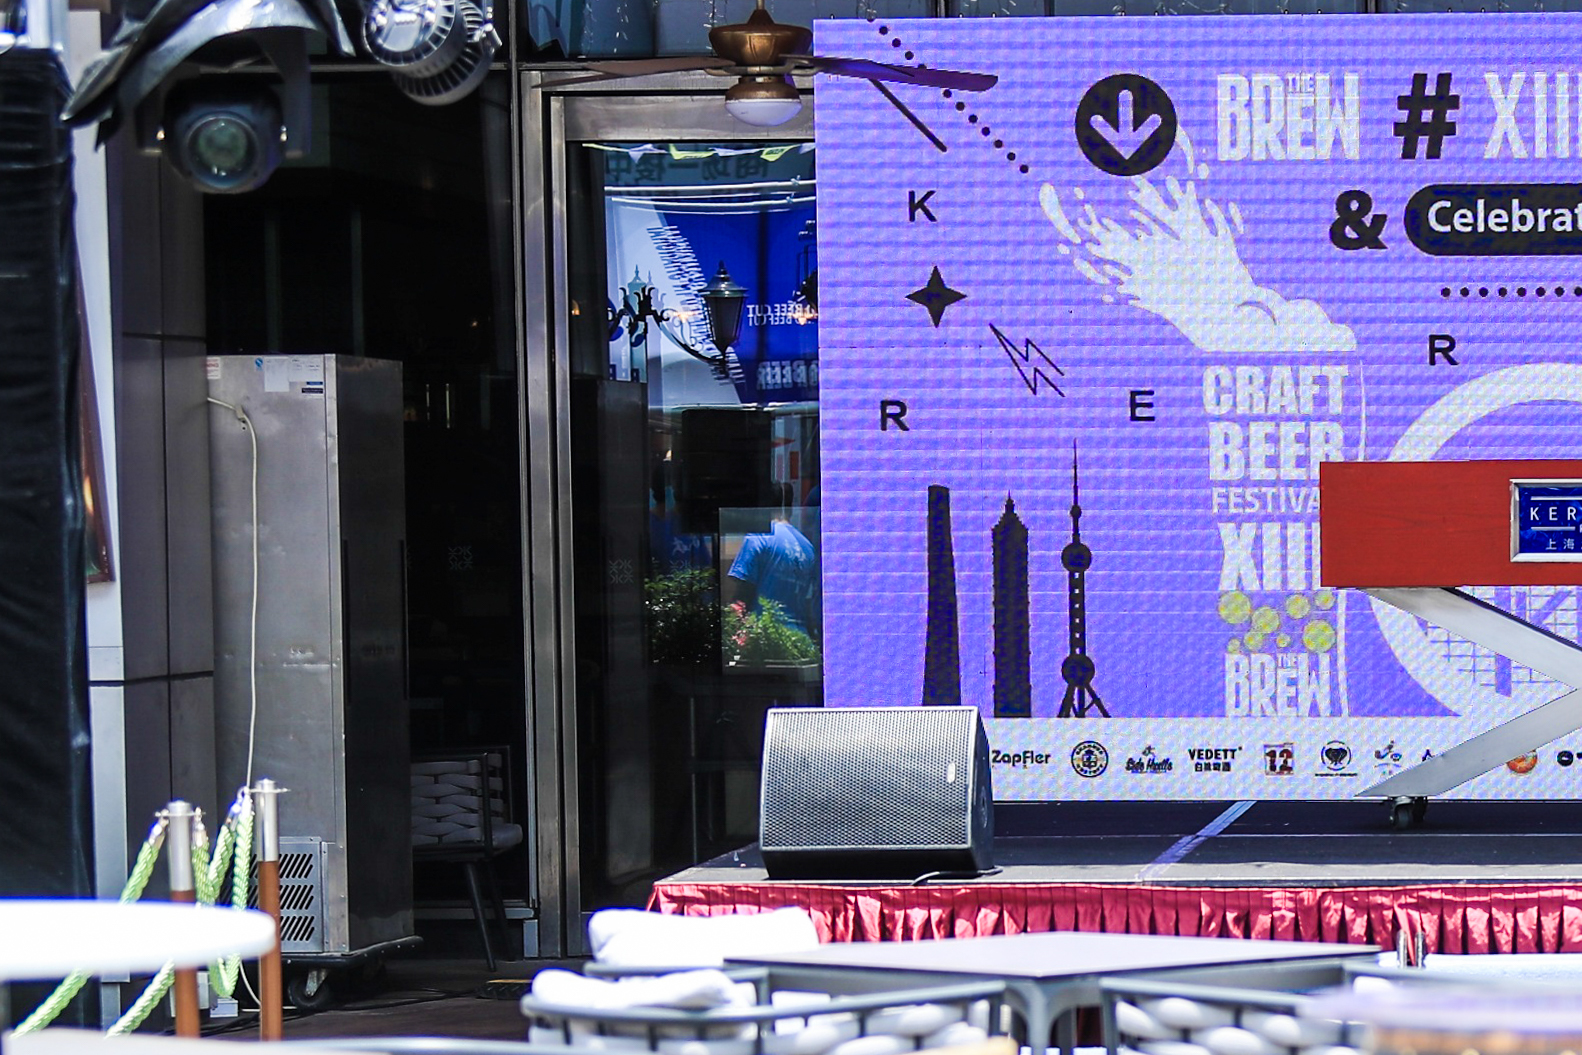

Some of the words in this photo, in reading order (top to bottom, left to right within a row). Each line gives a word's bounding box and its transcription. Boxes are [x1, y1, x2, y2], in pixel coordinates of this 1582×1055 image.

[1217, 73, 1360, 160] BREW
[1394, 73, 1460, 160] #
[909, 191, 938, 224] K
[1330, 190, 1389, 252] &
[1429, 335, 1460, 367] R
[1130, 390, 1157, 423] E
[1203, 365, 1349, 416] CRAFT
[880, 400, 910, 433] R
[1209, 422, 1345, 480] BEER
[1213, 487, 1319, 515] FESTIVA
[1225, 652, 1332, 717] BREW
[1188, 748, 1237, 760] VEDETT
